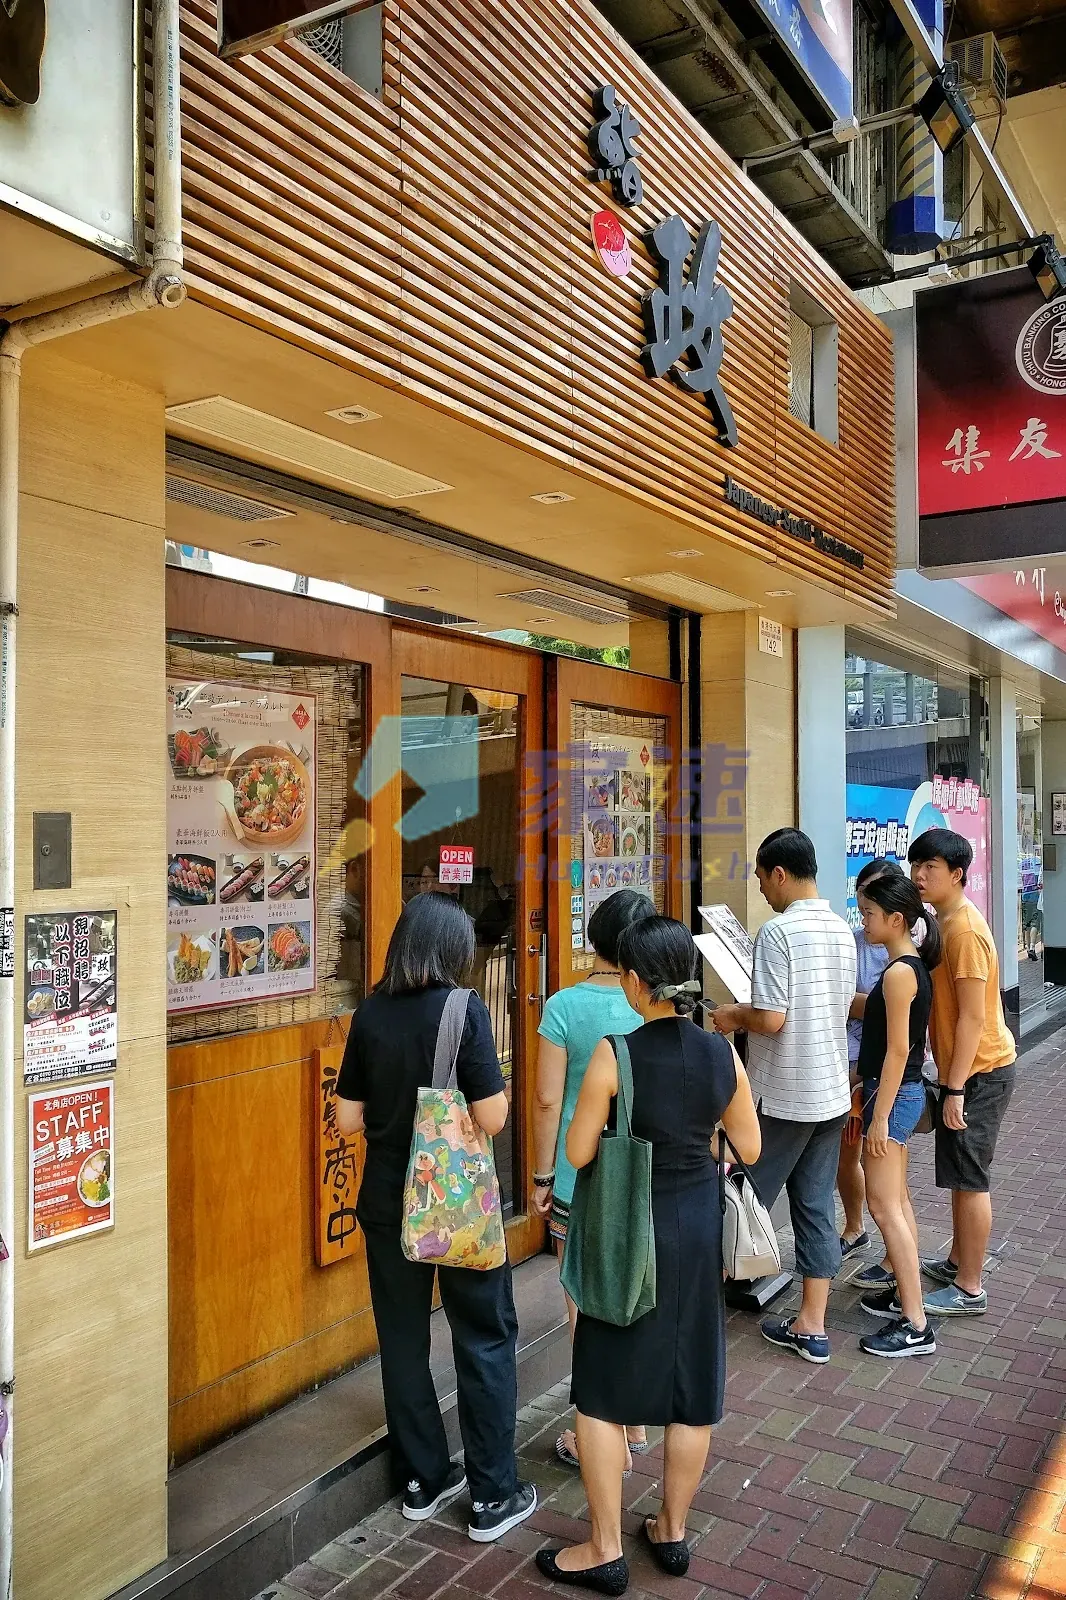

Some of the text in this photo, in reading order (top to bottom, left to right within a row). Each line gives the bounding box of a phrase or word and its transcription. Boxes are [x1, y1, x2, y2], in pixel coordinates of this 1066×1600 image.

[1024, 311, 1051, 349] BANKING
[1023, 350, 1038, 377] CHIYU
[1040, 376, 1066, 388] HONG
[941, 417, 1063, 475] 集友
[725, 474, 865, 570] Japanese Sushi Restaurant
[766, 638, 777, 653] 142
[933, 778, 979, 812] 保險計劃服務
[441, 849, 473, 863] OPEN
[847, 906, 865, 929] 255
[74, 917, 89, 979] 現招聘
[97, 956, 110, 972] 政
[54, 924, 70, 1009] 以下職位
[36, 1101, 104, 1142] STAFF
[56, 1124, 109, 1161] 募集中
